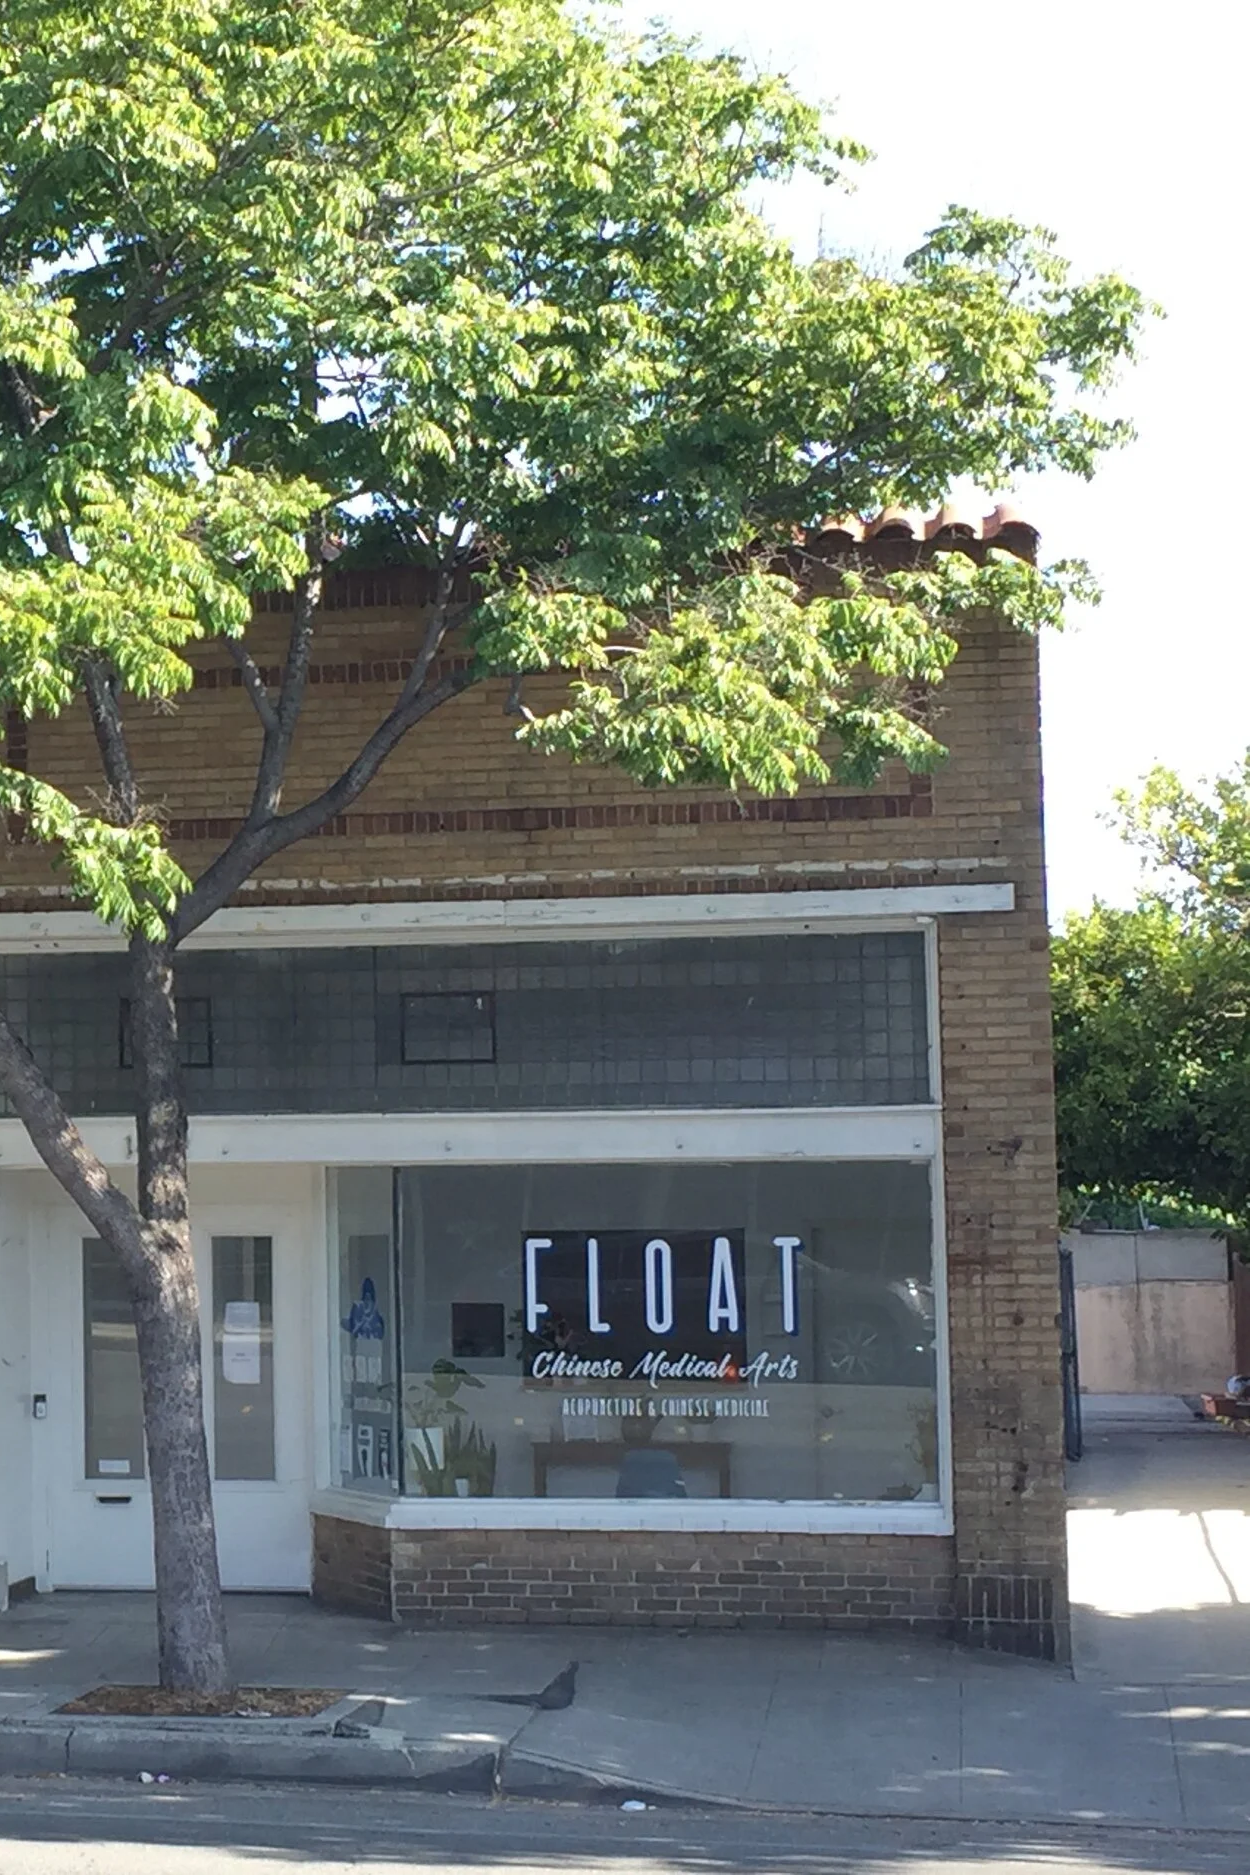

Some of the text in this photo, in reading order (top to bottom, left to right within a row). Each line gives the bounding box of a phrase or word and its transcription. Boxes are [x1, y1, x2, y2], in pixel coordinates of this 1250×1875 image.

[525, 1236, 802, 1335] FLOAT
[532, 1350, 799, 1389] Chinese Medical Arts
[562, 1398, 643, 1416] ACUPUNCTURE
[661, 1398, 710, 1416] CHINESE
[715, 1399, 770, 1417] MEDICINE
